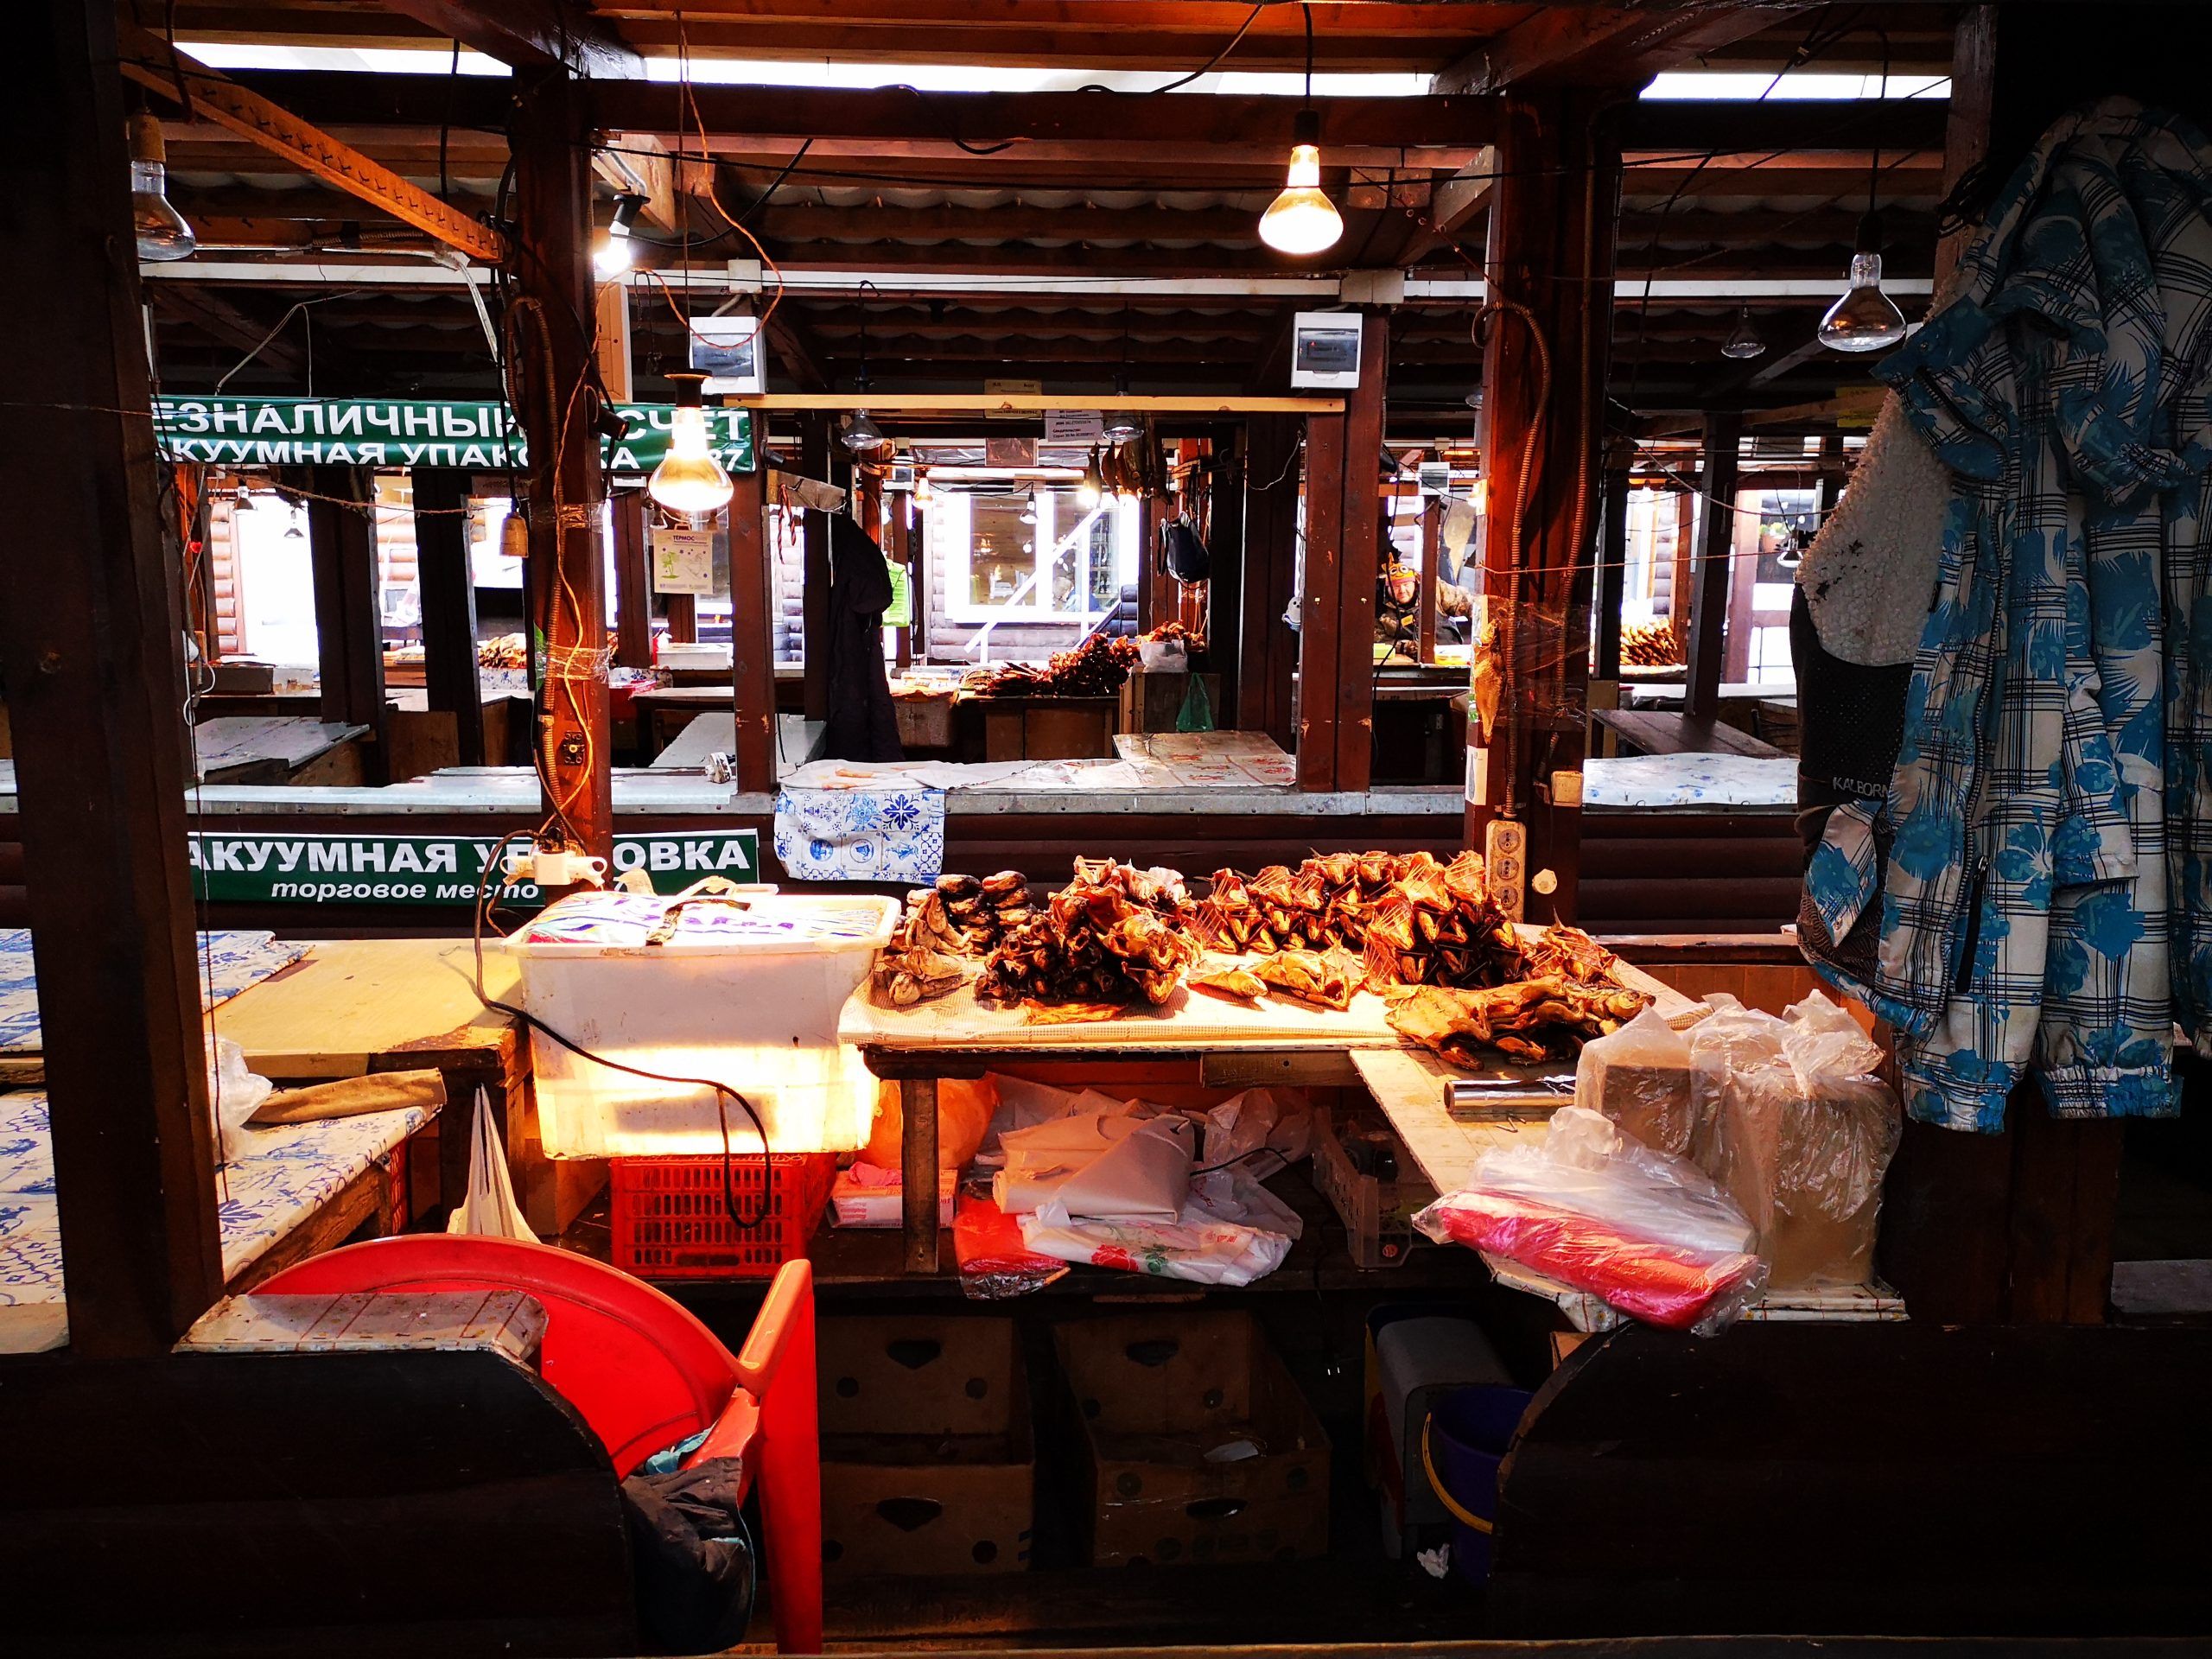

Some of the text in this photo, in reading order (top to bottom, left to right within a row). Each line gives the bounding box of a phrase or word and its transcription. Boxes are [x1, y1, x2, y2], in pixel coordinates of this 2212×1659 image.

[474, 840, 750, 873] УПОВКА
[271, 883, 427, 903] торговое
[435, 883, 539, 899] место
